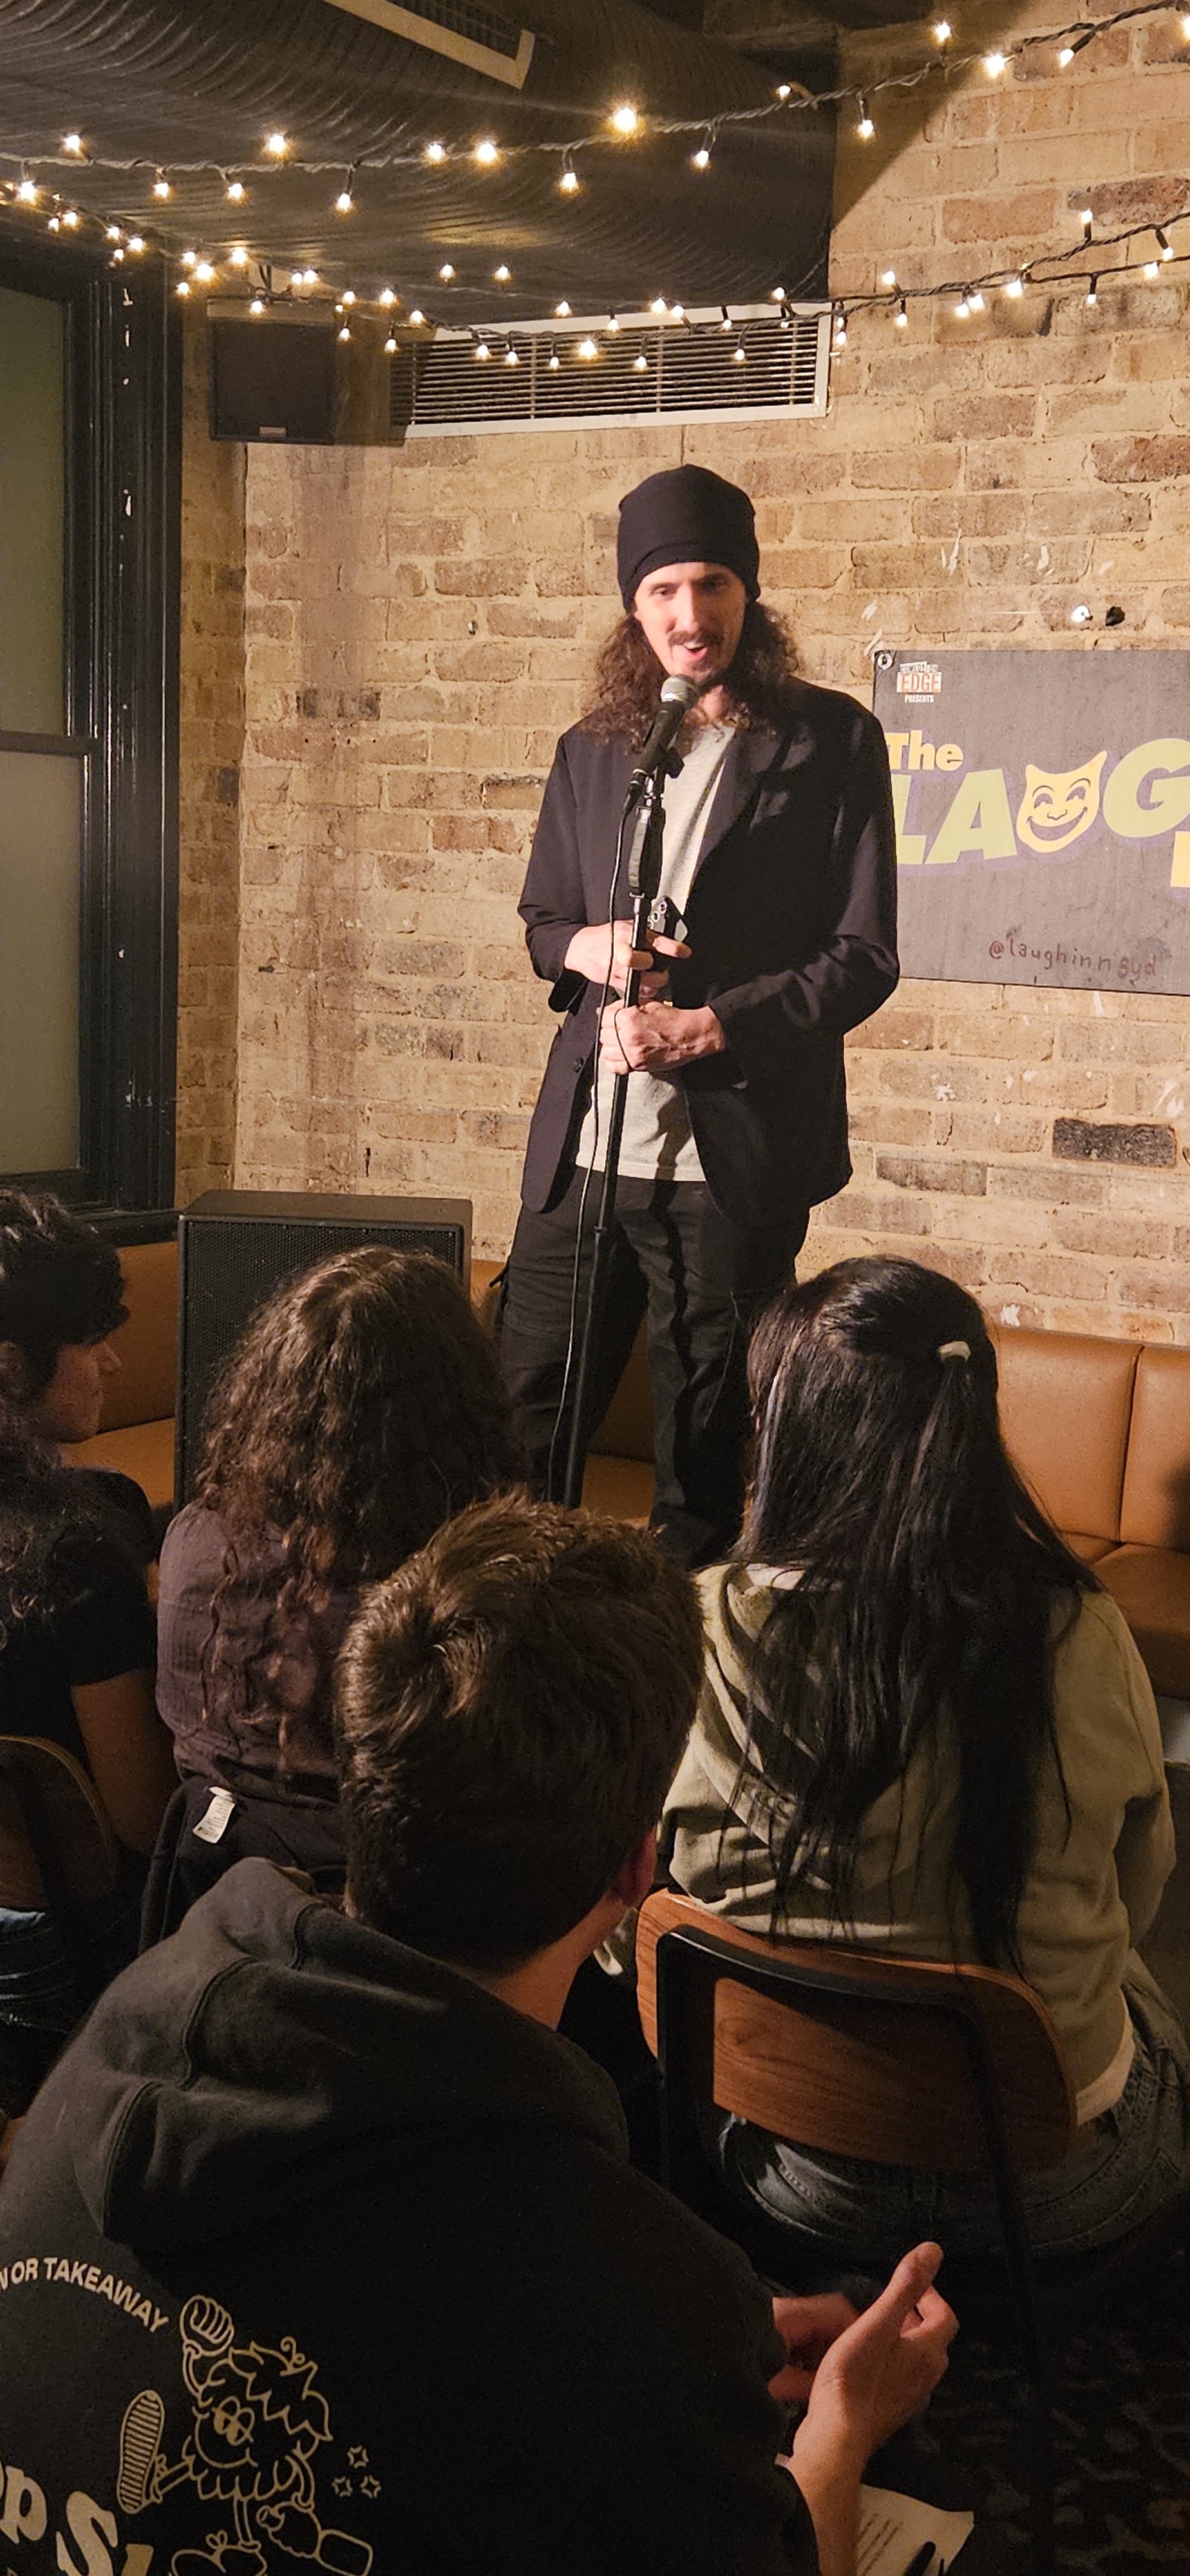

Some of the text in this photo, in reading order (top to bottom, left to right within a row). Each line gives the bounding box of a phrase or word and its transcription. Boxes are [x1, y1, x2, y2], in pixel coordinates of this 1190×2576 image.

[902, 673, 940, 692] EDGE
[904, 694, 934, 703] PRESENTS
[884, 730, 964, 771] The
[11, 2258, 39, 2284] OR
[44, 2257, 169, 2333] TAKEAWAY
